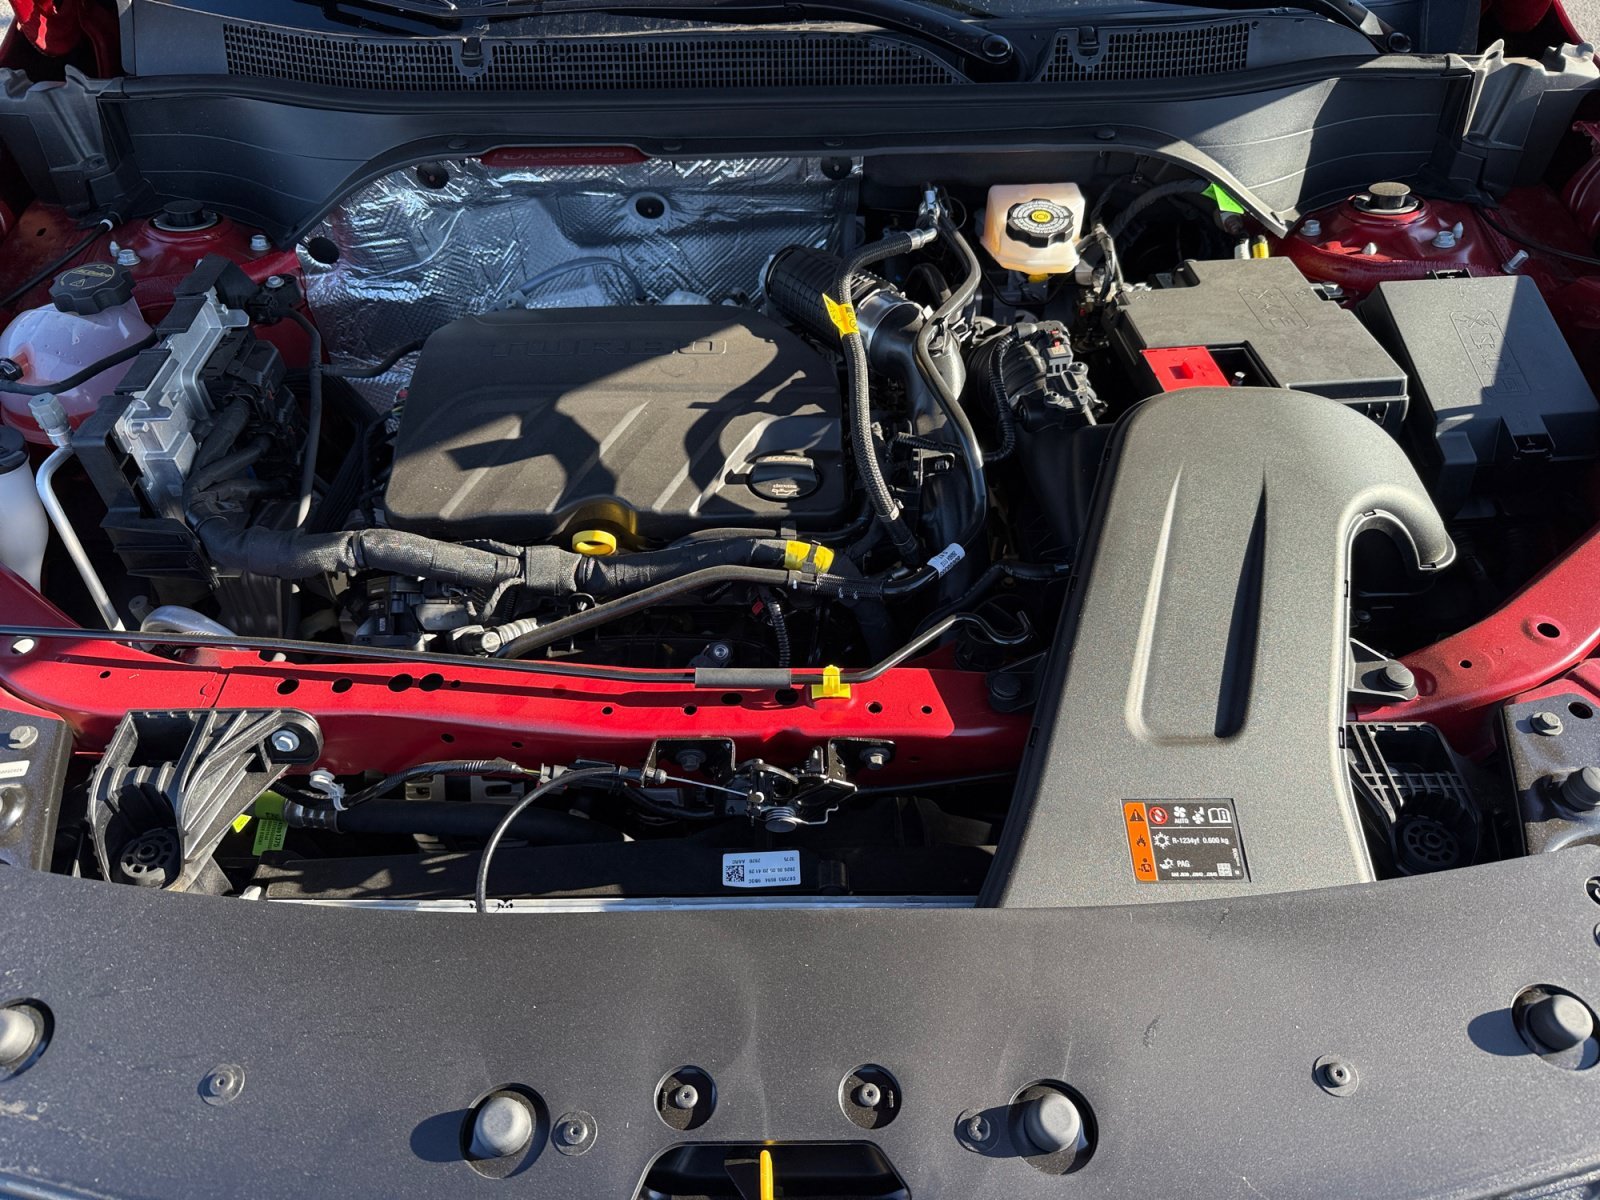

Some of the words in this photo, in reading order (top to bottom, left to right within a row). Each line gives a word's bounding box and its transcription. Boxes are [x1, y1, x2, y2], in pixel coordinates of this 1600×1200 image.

[479, 338, 728, 358] TURBO
[1171, 837, 1200, 846] R-1234yf
[1202, 836, 1220, 844] 0.600
[1220, 836, 1230, 845] kg
[1176, 859, 1191, 868] PAG
